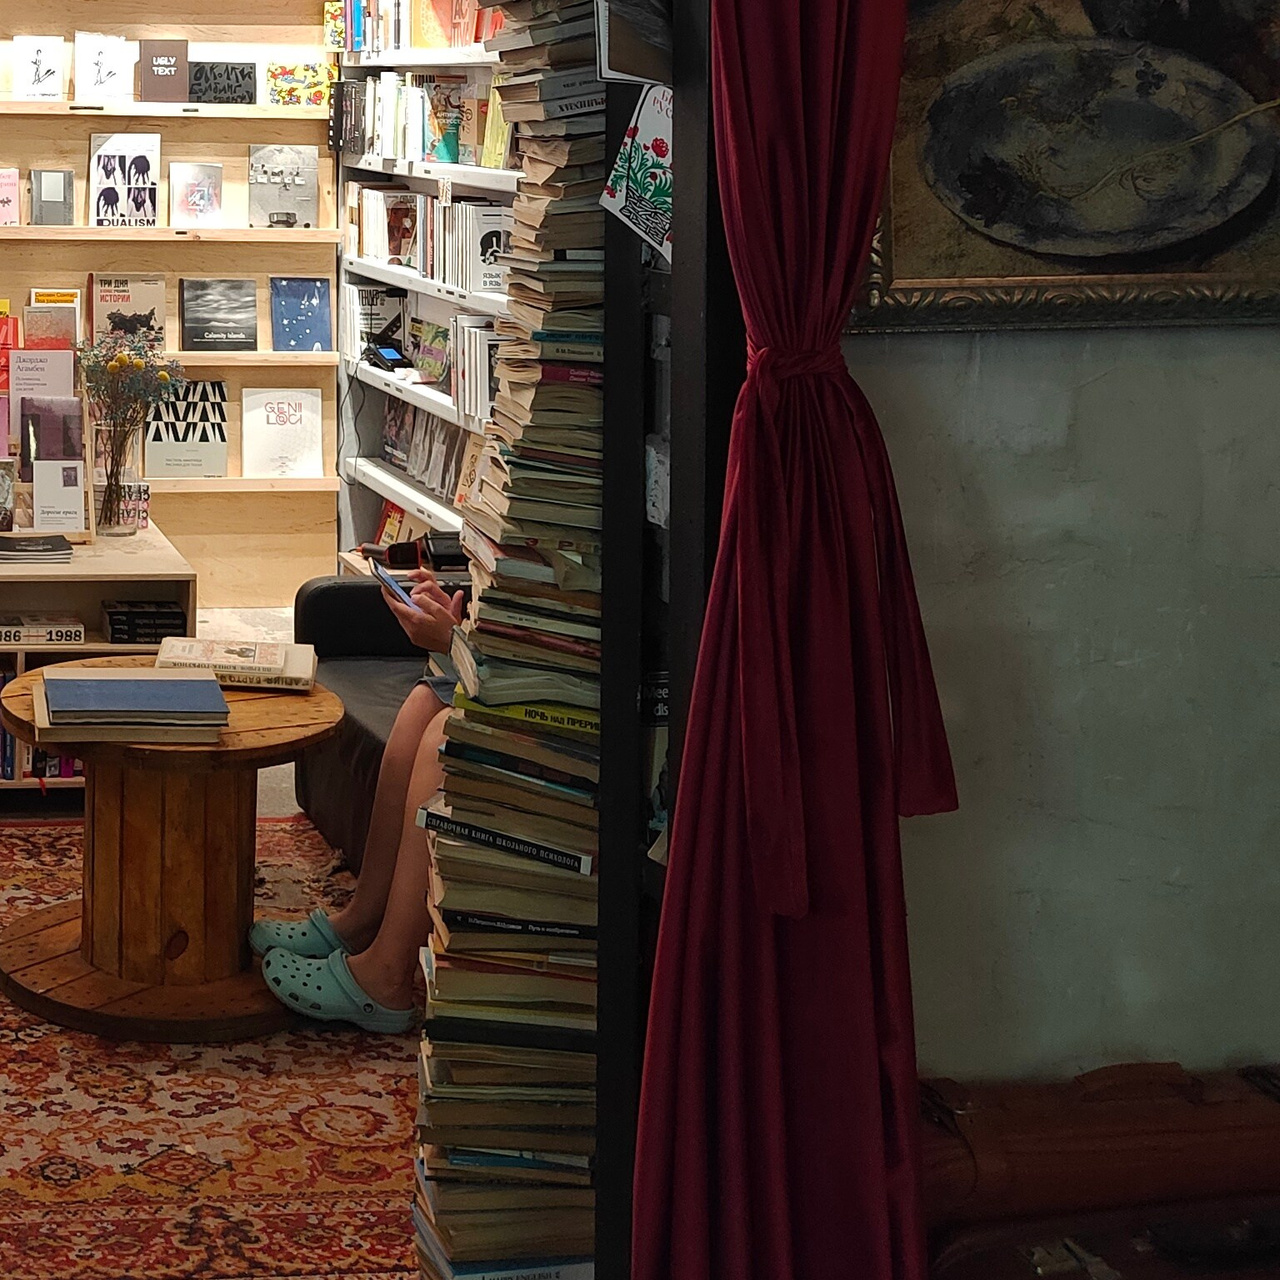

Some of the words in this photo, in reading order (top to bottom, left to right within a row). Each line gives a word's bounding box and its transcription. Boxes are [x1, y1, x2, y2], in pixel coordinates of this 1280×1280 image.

[152, 56, 177, 66] UGLY
[152, 66, 178, 76] TEXT
[101, 218, 156, 227] DUALISM
[98, 278, 113, 289] ТРИ
[113, 279, 129, 289] ДНЯ
[99, 293, 131, 303] ИСТОРИИ
[204, 331, 226, 340] Calamity
[227, 331, 246, 339] Islands
[14, 355, 48, 365] Джорджо
[14, 365, 46, 373] Агамбен
[264, 401, 303, 415] GENII
[265, 413, 303, 426] LOCI
[46, 629, 83, 643] 1988
[524, 706, 549, 723] НОЧЬ
[550, 714, 566, 726] НАД
[426, 816, 469, 837] СПРАВОЧНАЯ
[471, 830, 494, 843] КНИГА
[494, 835, 537, 856] ШКОЛЬНОГО
[538, 848, 580, 869] ПСИХОЛОГА
